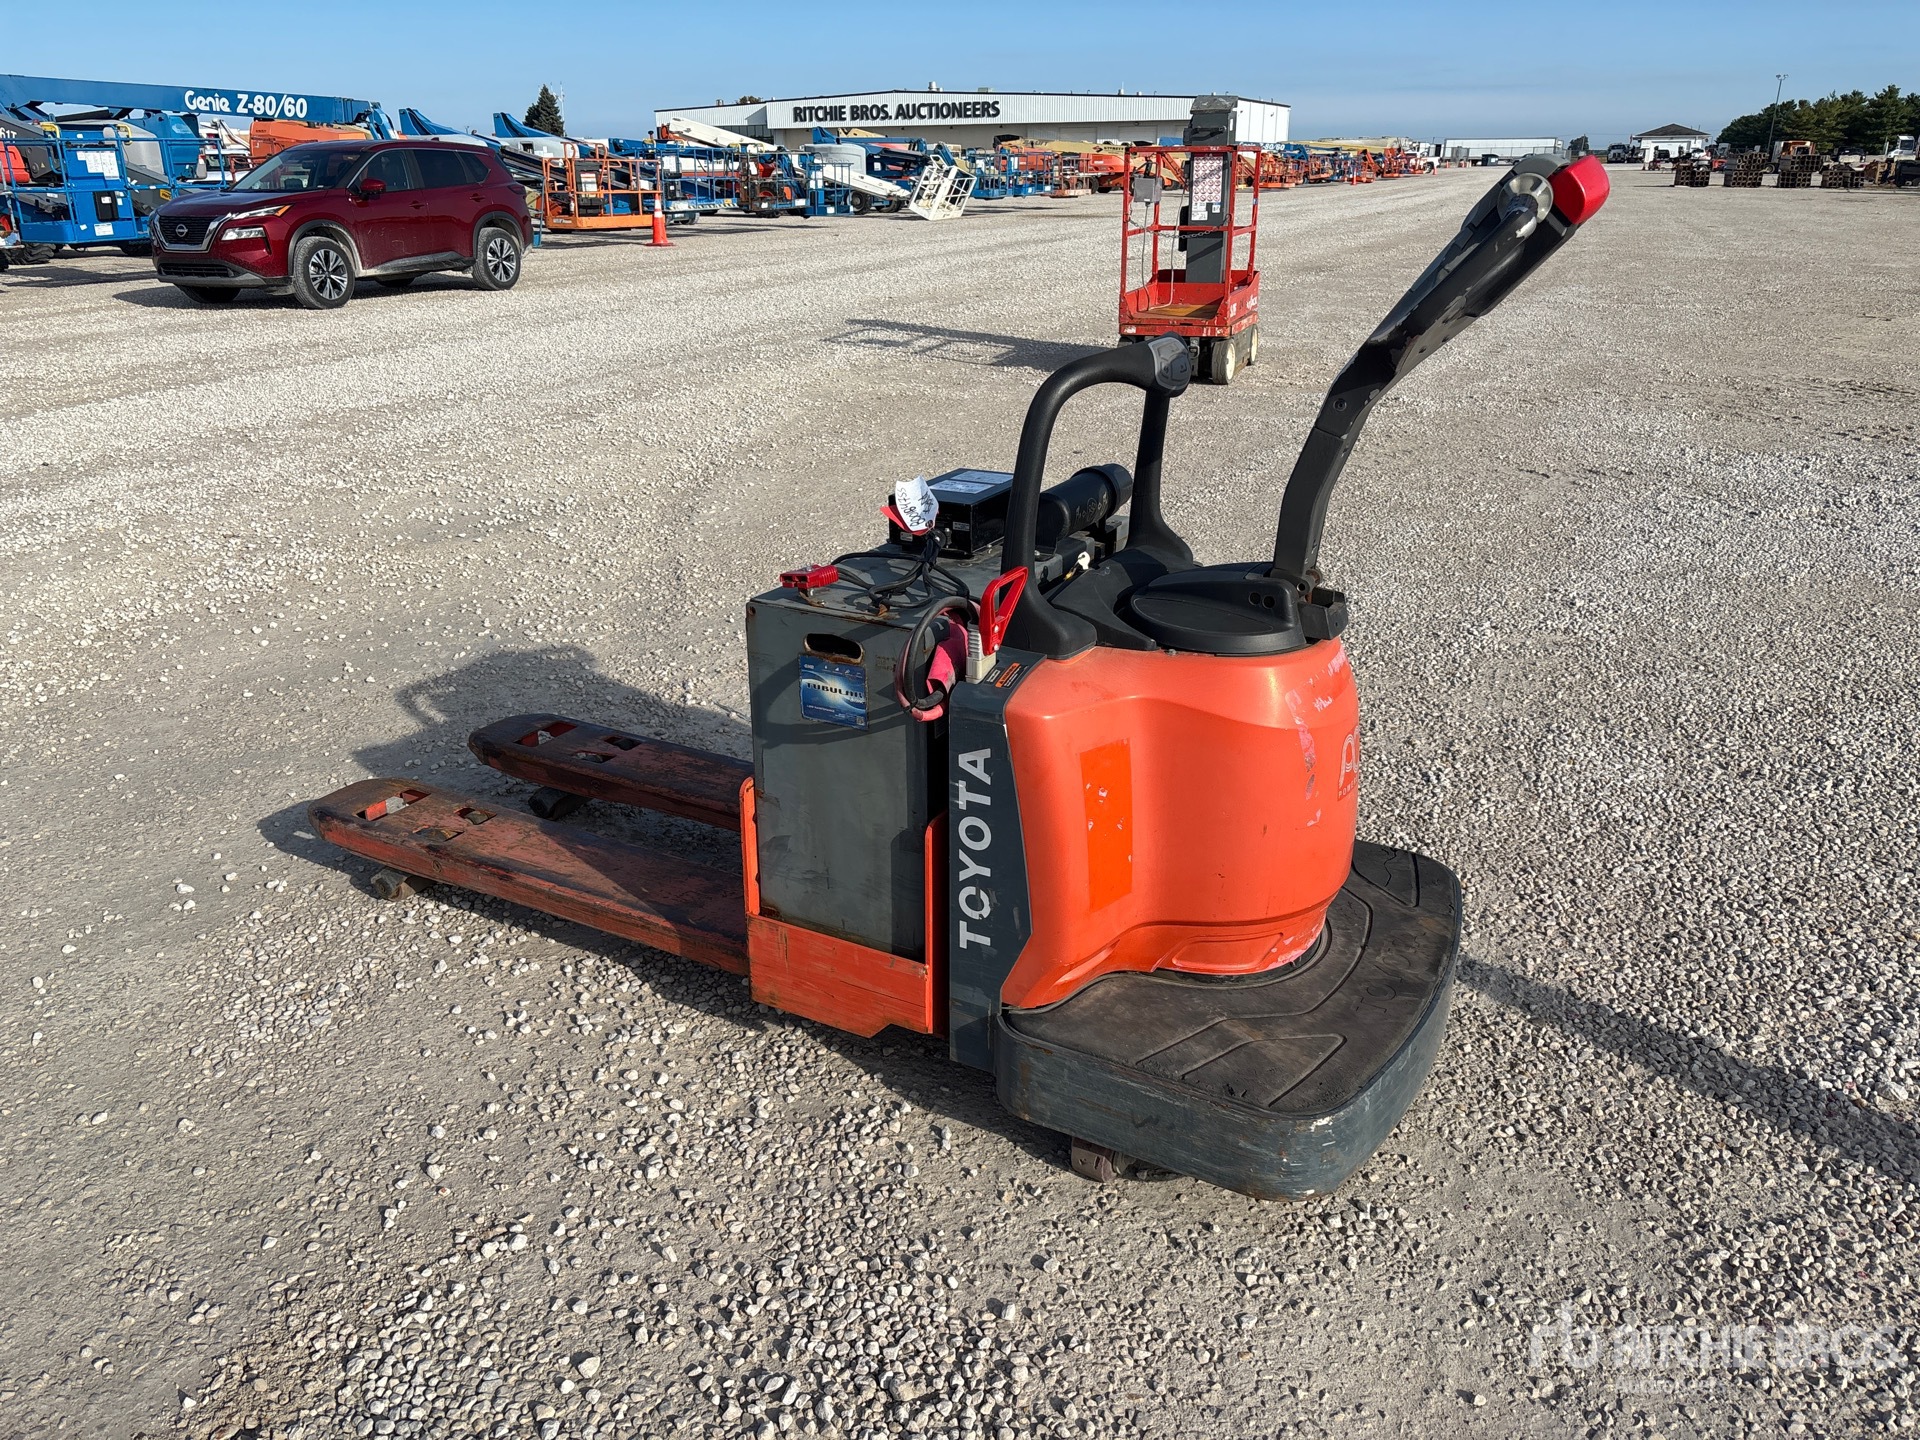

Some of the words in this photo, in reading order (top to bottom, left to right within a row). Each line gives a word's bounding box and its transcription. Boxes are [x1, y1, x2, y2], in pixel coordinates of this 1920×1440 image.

[184, 90, 232, 112] Genie
[236, 93, 308, 119] Z-80/60
[793, 105, 846, 122] RITCHIE
[849, 104, 892, 121] BROS.
[895, 100, 1000, 120] AUCTIONEERS
[958, 748, 991, 950] TOYOTA
